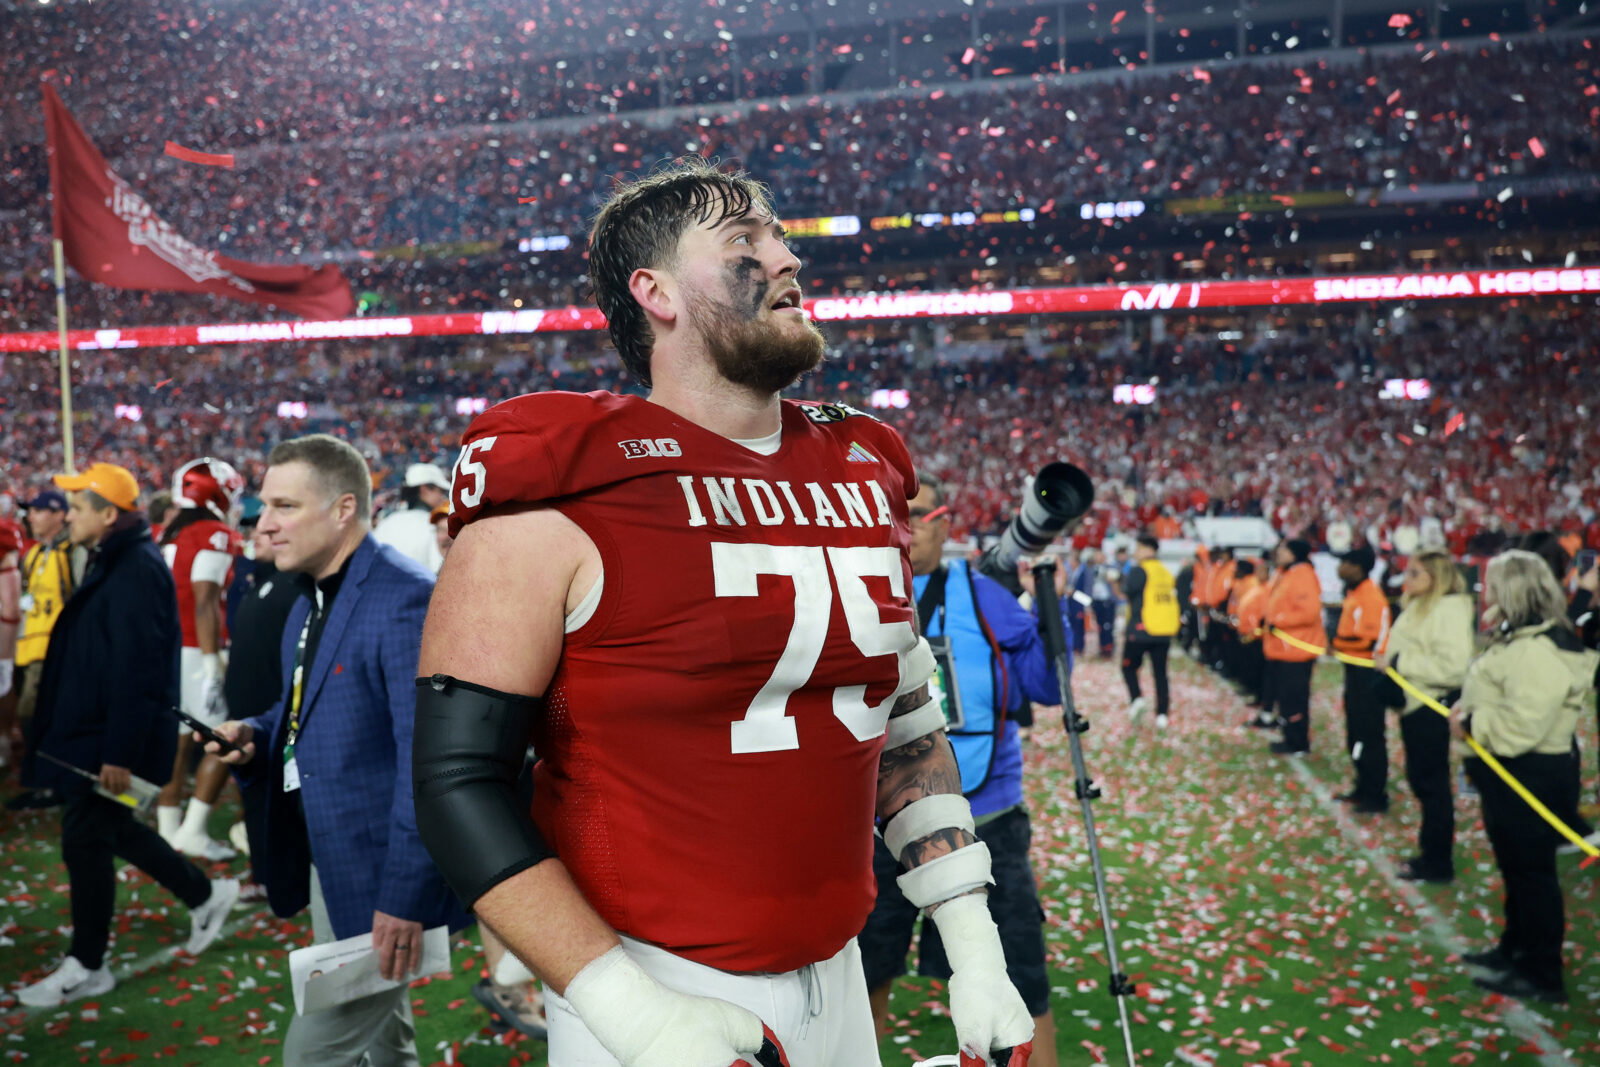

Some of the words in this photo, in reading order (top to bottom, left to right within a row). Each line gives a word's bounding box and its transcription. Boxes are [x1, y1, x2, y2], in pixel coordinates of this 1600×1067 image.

[813, 292, 1013, 319] CHAMPIONS
[1314, 273, 1474, 300] INDIANA
[676, 475, 894, 528] INDIANA
[710, 541, 918, 754] 75
